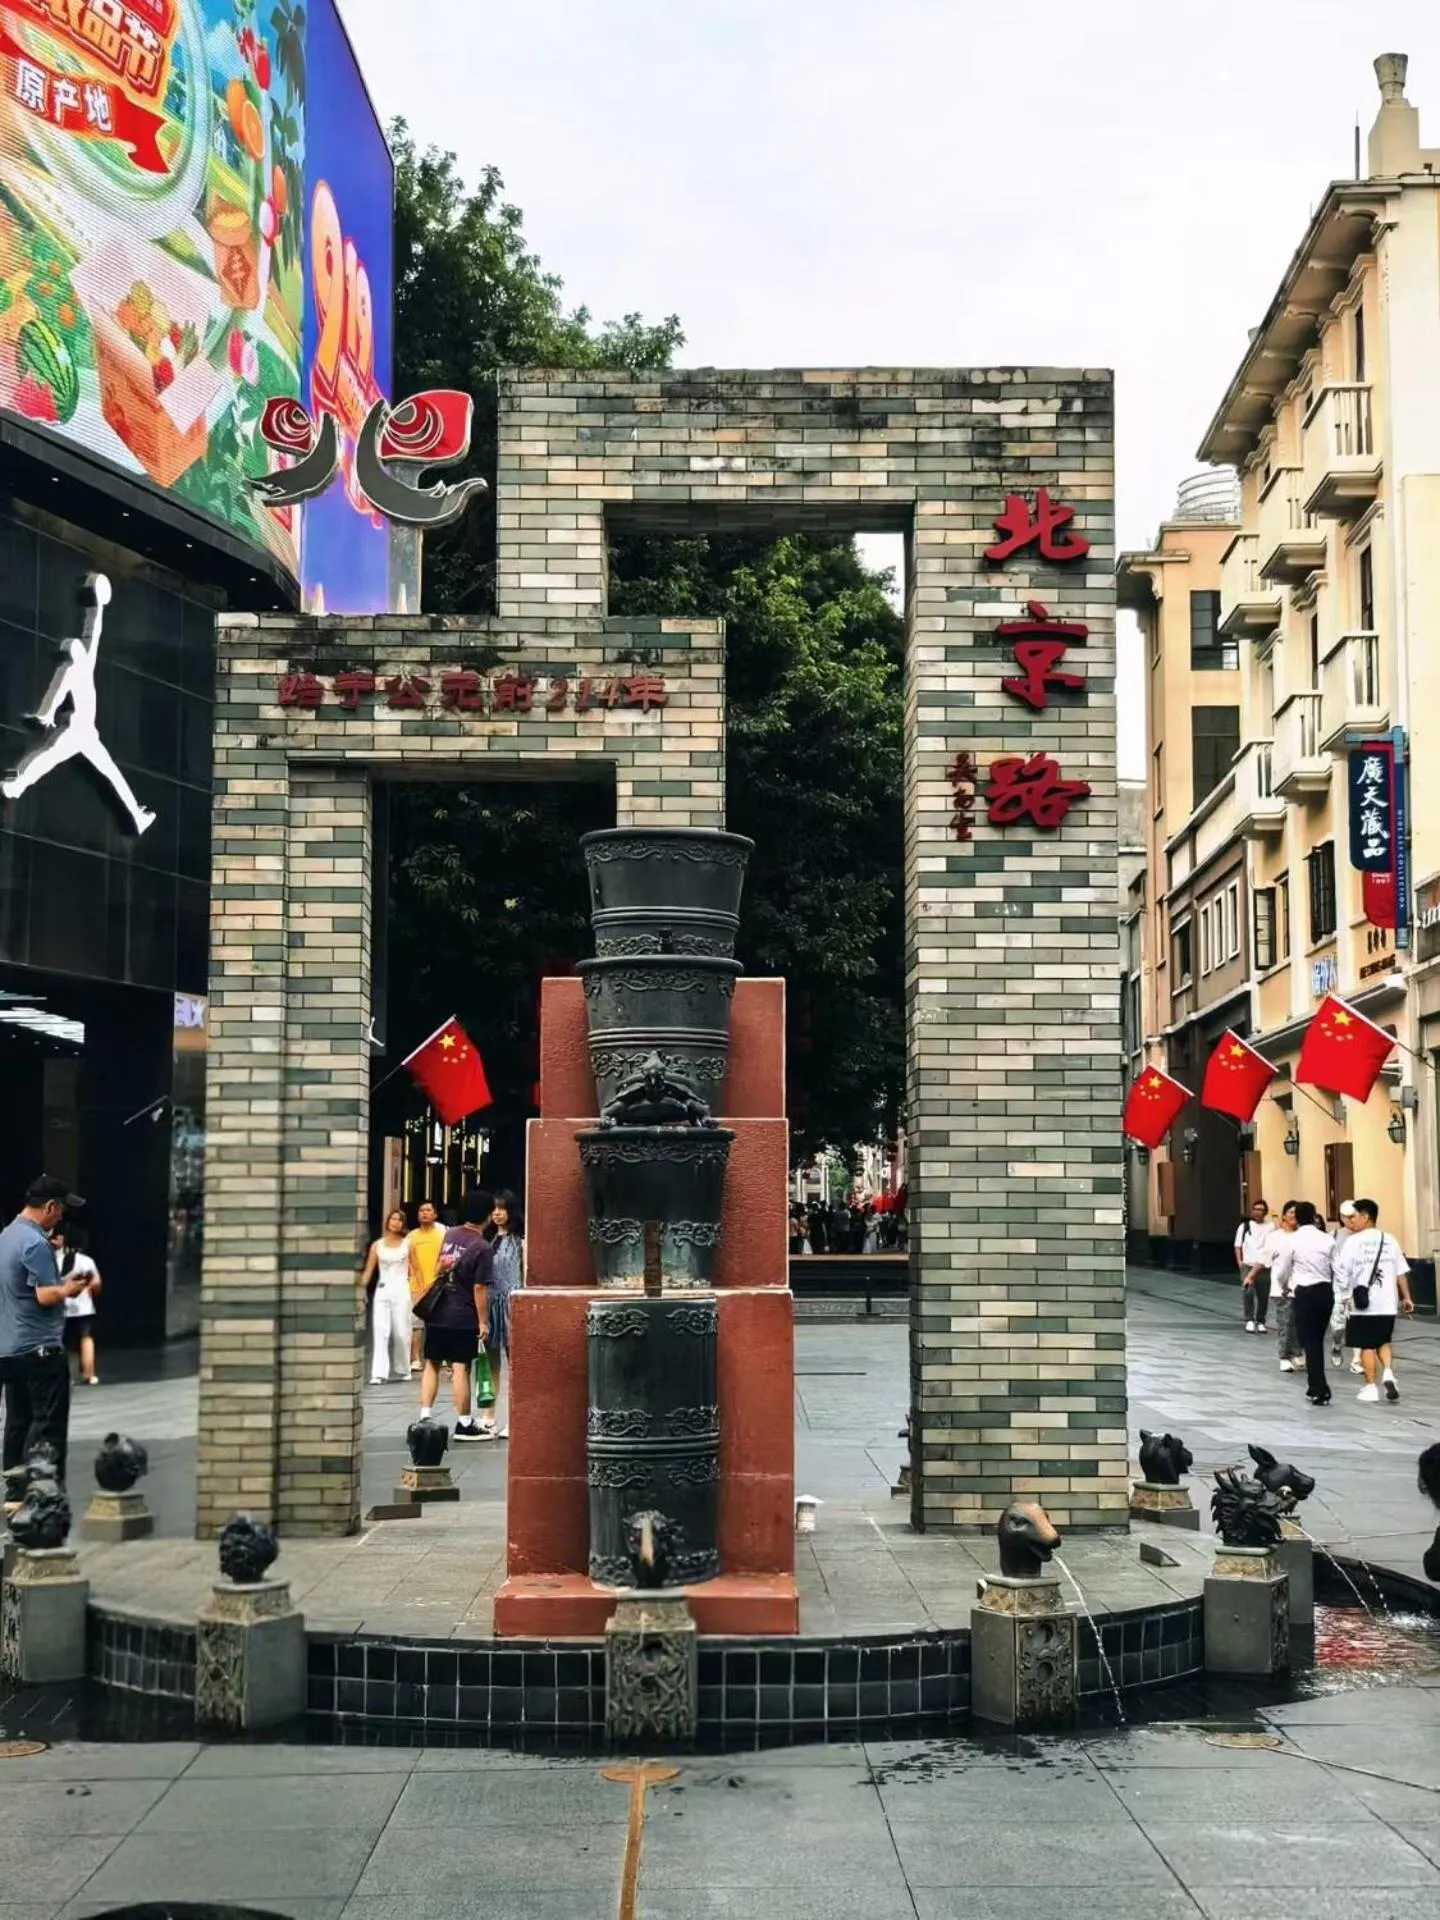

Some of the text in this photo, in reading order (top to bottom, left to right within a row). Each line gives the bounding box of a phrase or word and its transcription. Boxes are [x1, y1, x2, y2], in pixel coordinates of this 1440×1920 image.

[16, 57, 112, 132] 原产地
[983, 487, 1091, 829] 北京路
